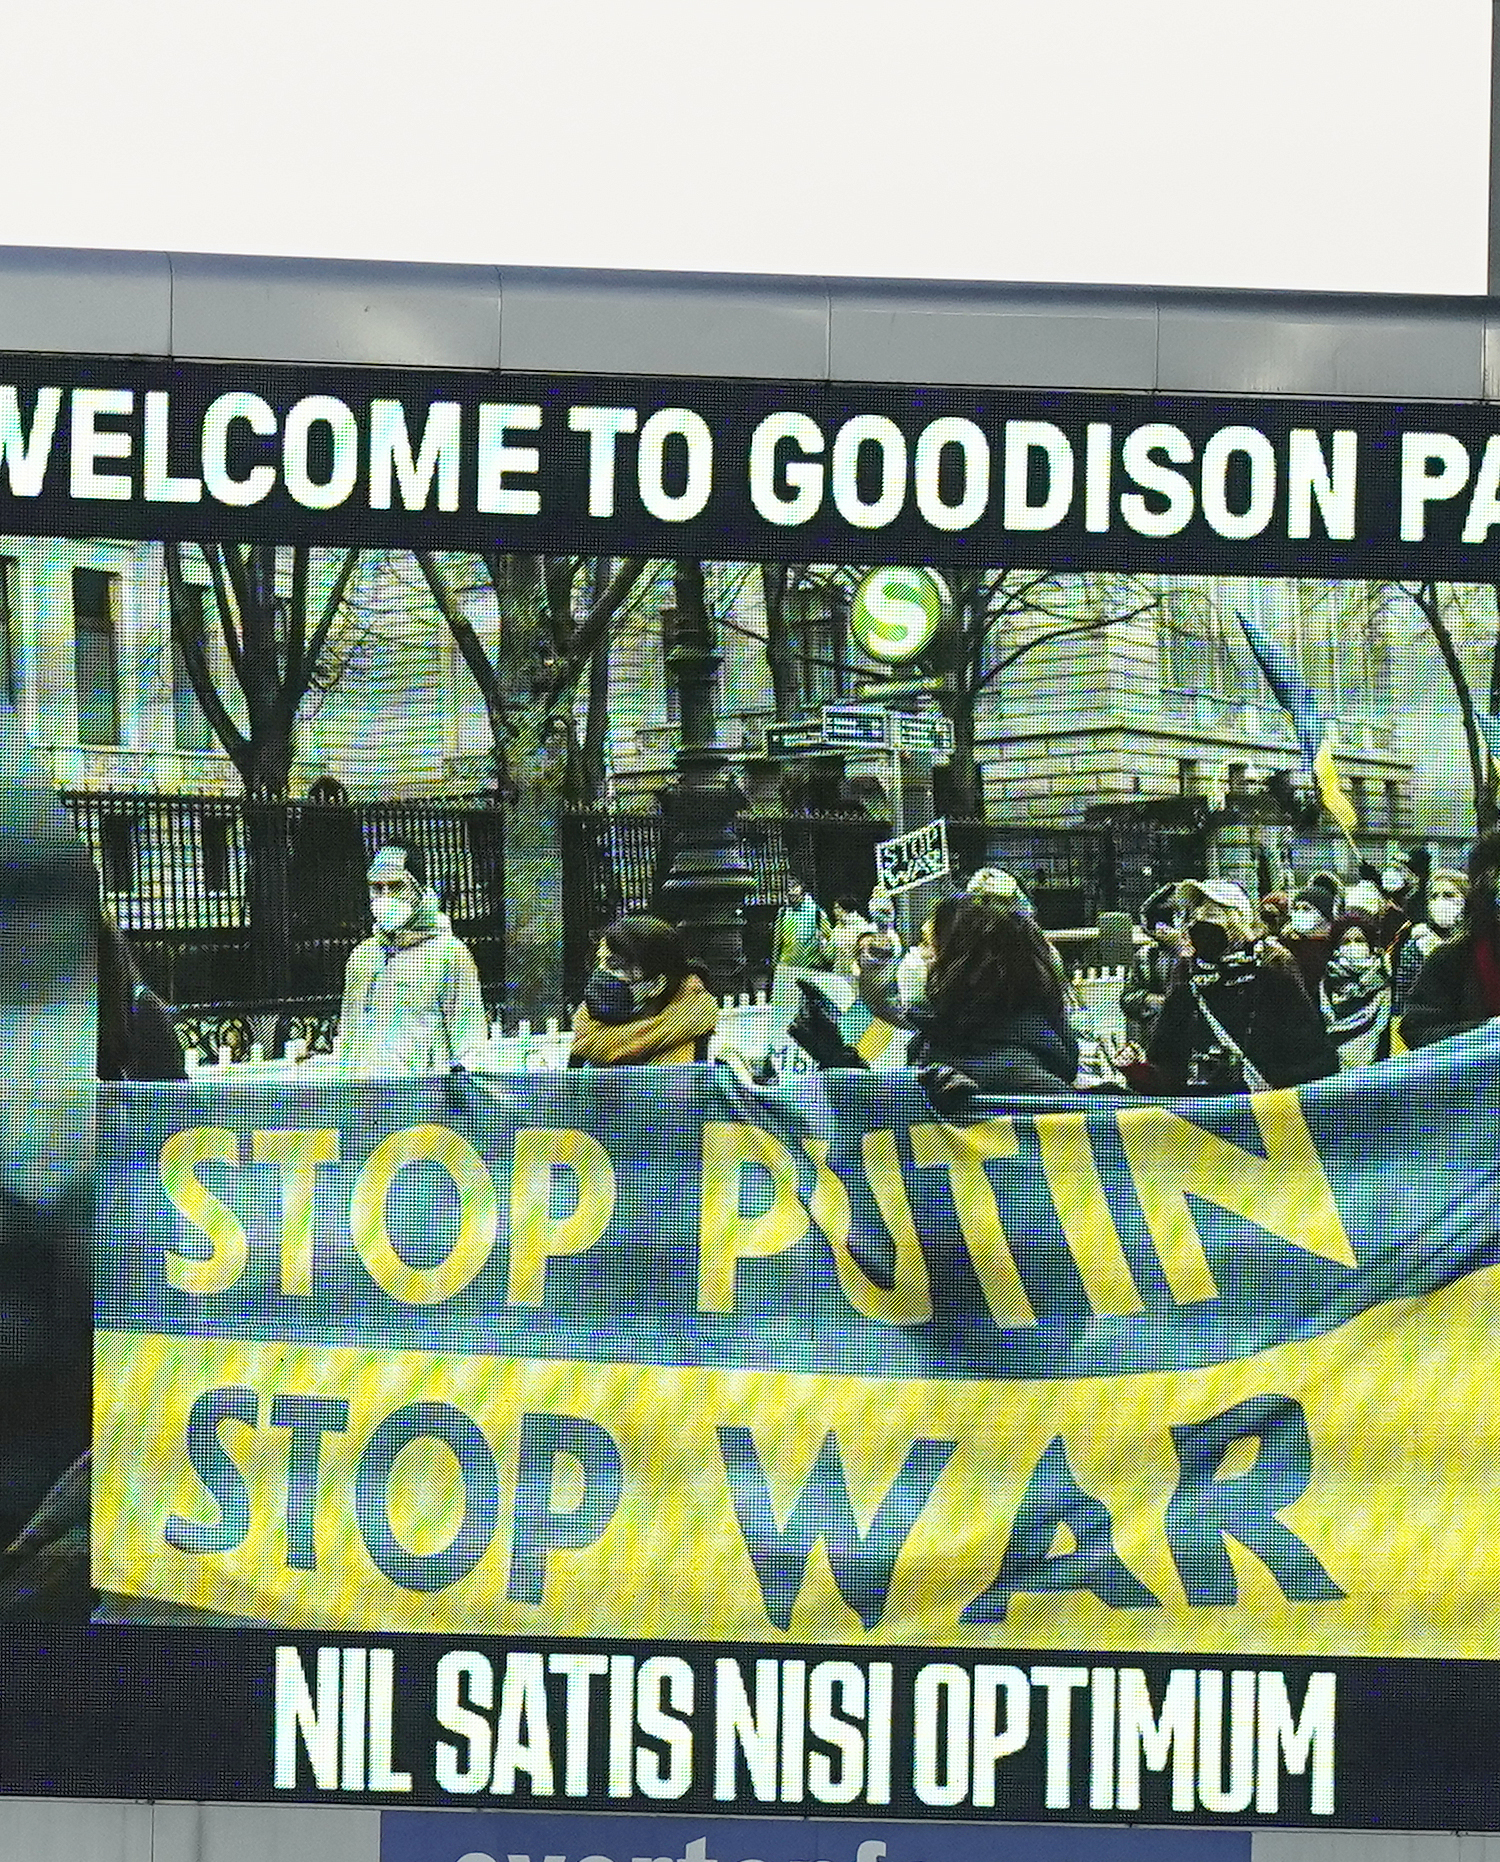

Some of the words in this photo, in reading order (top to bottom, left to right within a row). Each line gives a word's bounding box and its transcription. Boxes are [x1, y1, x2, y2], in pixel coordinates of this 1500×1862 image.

[567, 407, 713, 522] TO
[749, 411, 1361, 541] GOODISON
[159, 1119, 615, 1312] STOP
[697, 1087, 1358, 1328] PUTIN
[162, 1385, 630, 1609] STOP
[717, 1393, 1351, 1632] WAR
[272, 1644, 414, 1792] NIL
[435, 1650, 692, 1801] SATIS
[714, 1657, 894, 1806] NISI
[913, 1663, 1337, 1815] OPTIMUM
